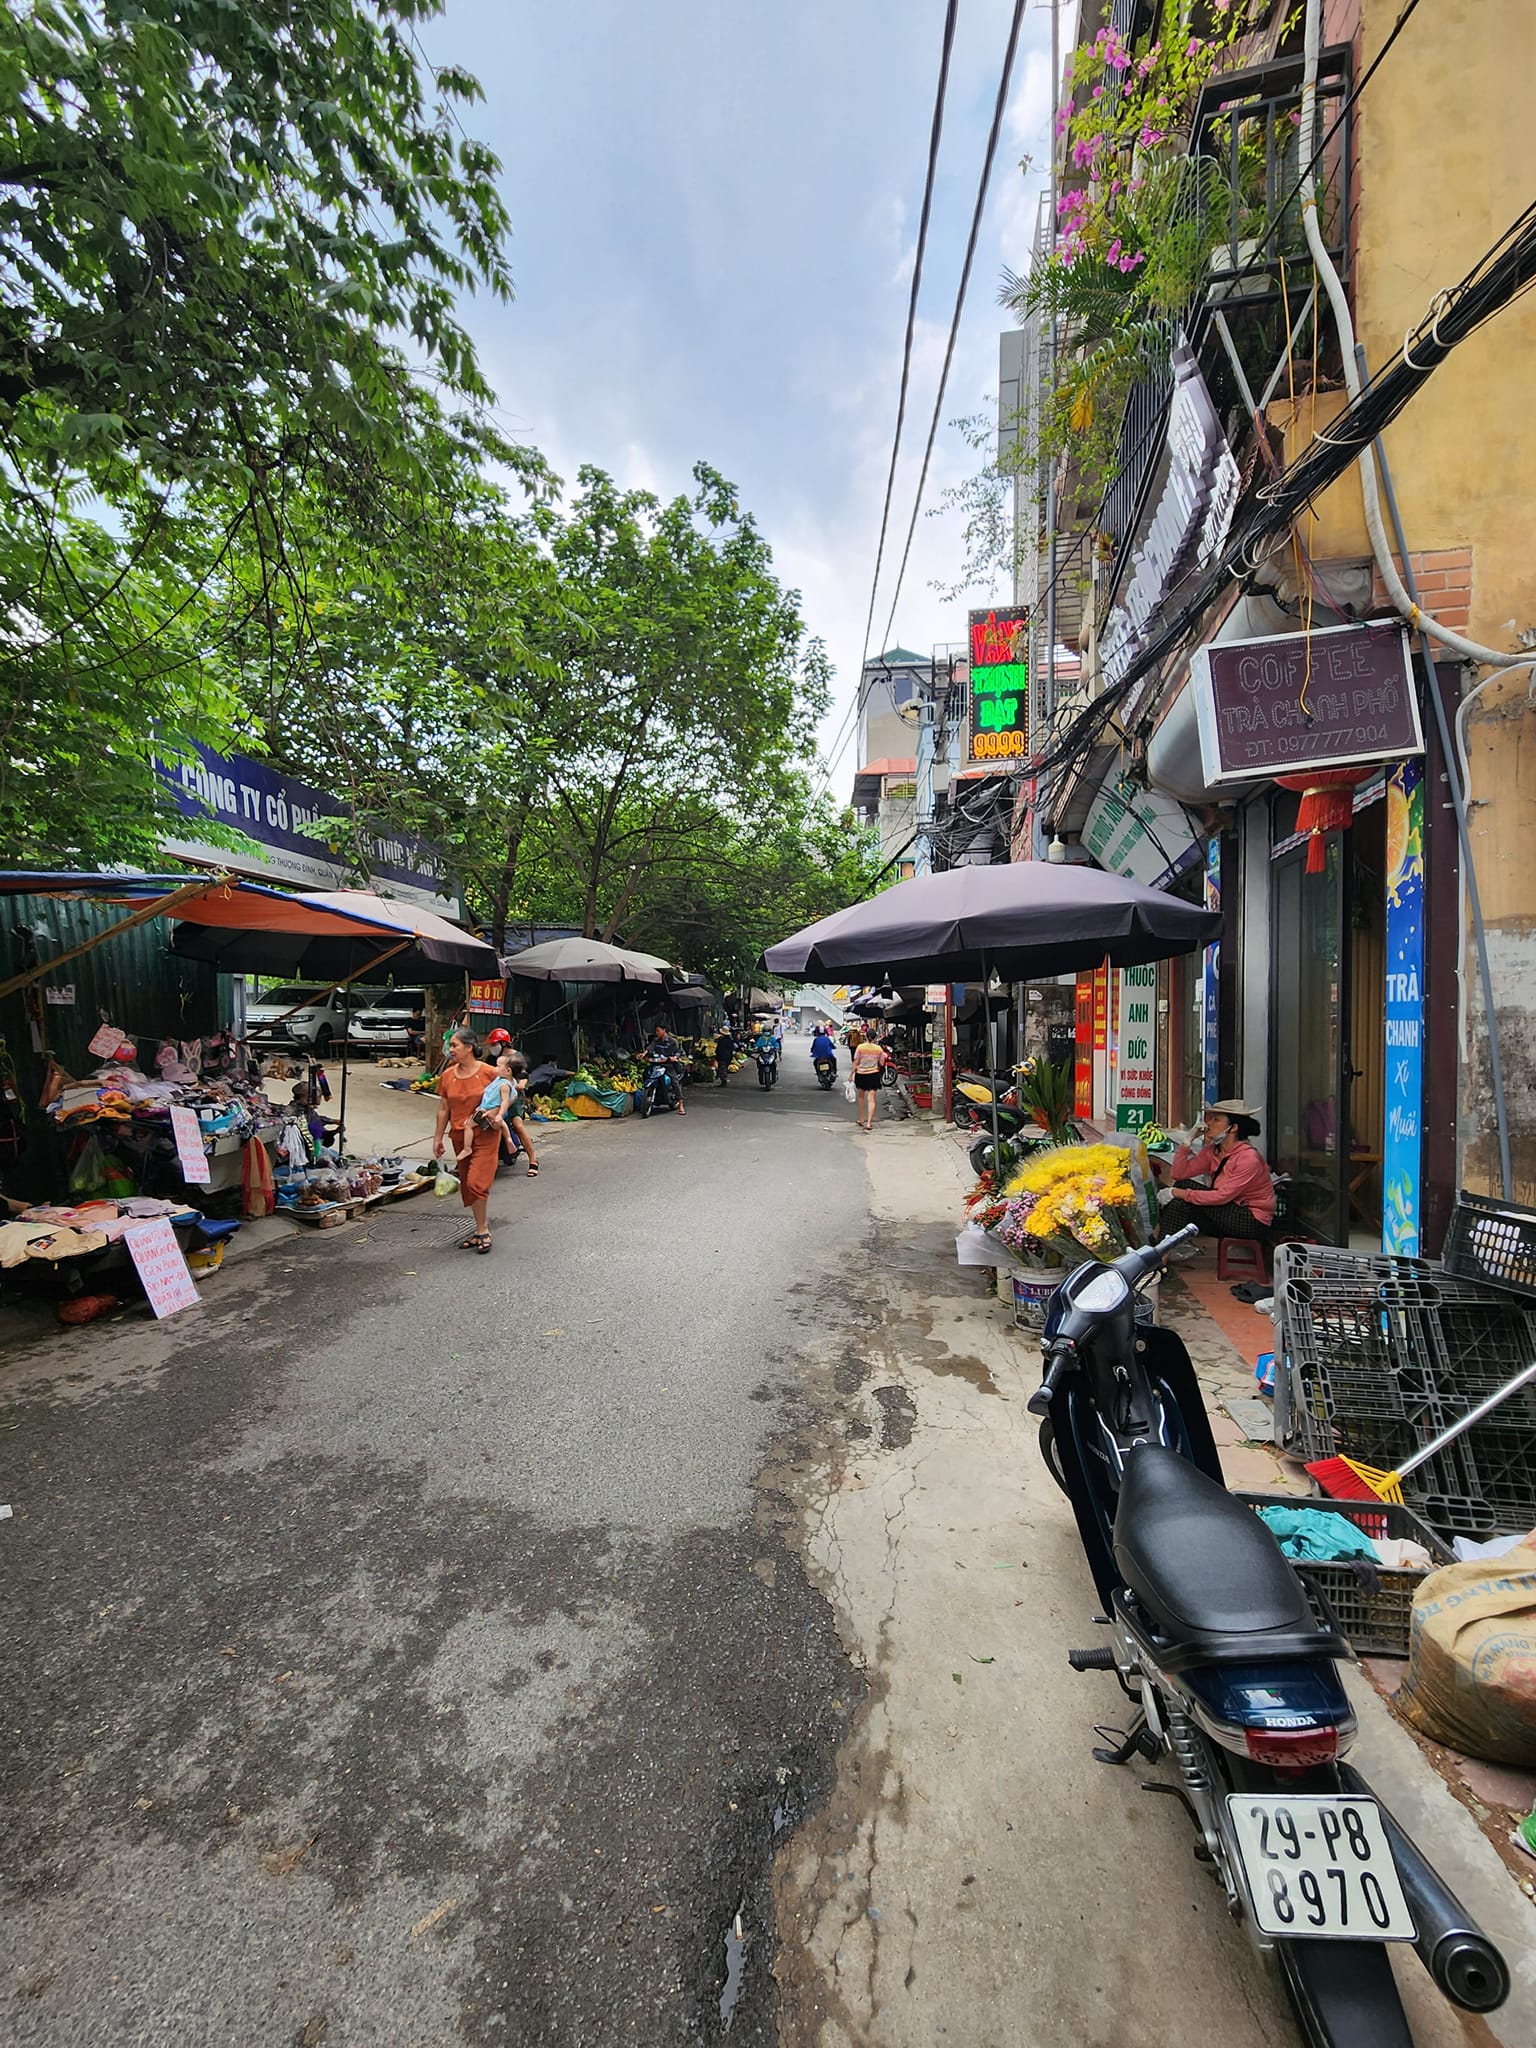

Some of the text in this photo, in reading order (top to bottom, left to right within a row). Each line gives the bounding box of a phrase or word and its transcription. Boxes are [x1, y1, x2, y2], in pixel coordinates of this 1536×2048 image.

[1239, 640, 1376, 693] COFFEE
[1222, 674, 1399, 734] TRÀ CHANH PHỐ
[973, 730, 1025, 757] 9999
[1246, 739, 1274, 758] ĐT:
[239, 783, 262, 822] TY
[266, 787, 289, 831] CỔ
[472, 985, 482, 998] XE
[1386, 964, 1419, 1002] TRÀ
[1128, 1003, 1149, 1023] ANH
[1386, 1019, 1419, 1047] CHANH
[1128, 1036, 1148, 1059] ĐỨC
[1127, 1109, 1144, 1124] 21
[1265, 1716, 1317, 1727] HONDA
[1251, 1807, 1371, 1861] 29-P8
[1266, 1868, 1390, 1929] 8970
